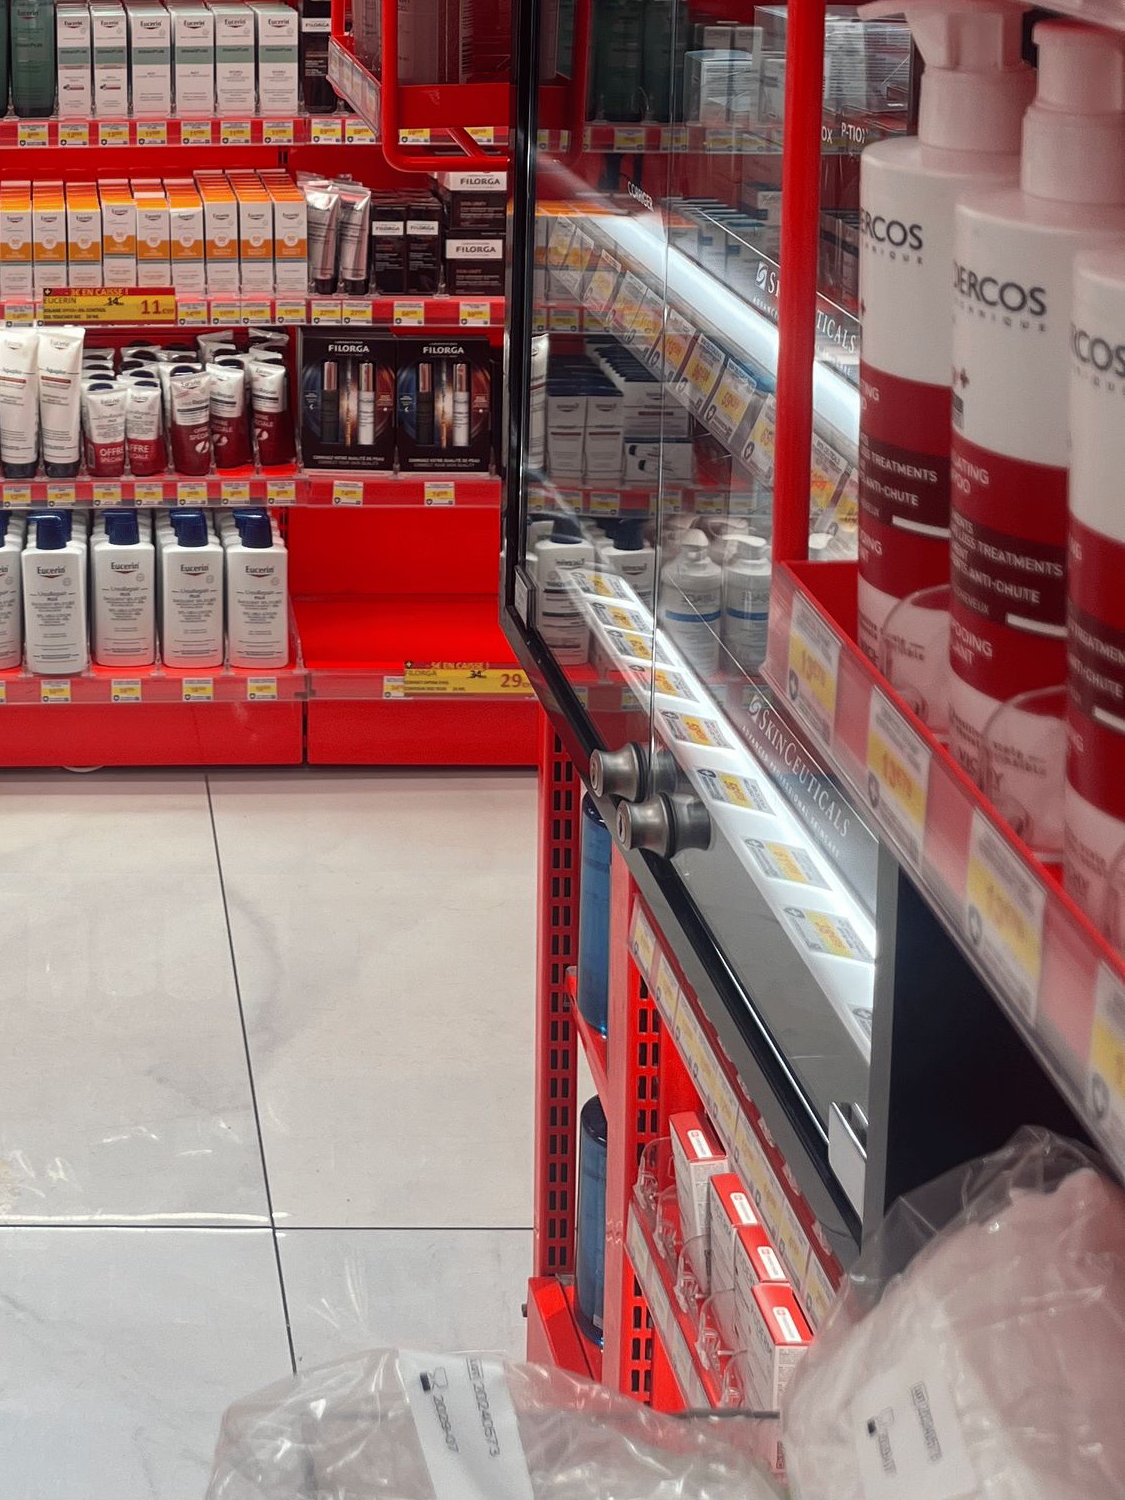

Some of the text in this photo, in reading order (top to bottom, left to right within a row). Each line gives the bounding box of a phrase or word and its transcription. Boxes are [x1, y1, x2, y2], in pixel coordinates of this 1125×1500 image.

[460, 176, 501, 187] FILORGA
[455, 245, 497, 254] FILORGA
[95, 288, 123, 296] CAISSE
[328, 344, 370, 354] FILORGA
[423, 345, 465, 355] FILORGA
[875, 453, 938, 483] TREATMENTS
[37, 566, 65, 576] Eucerin
[111, 562, 139, 572] Eucerin
[180, 564, 208, 573] Eucerin
[245, 565, 274, 574] Eucerin
[456, 662, 484, 670] CAISSE
[758, 706, 851, 839] SKINCEUTICALS
